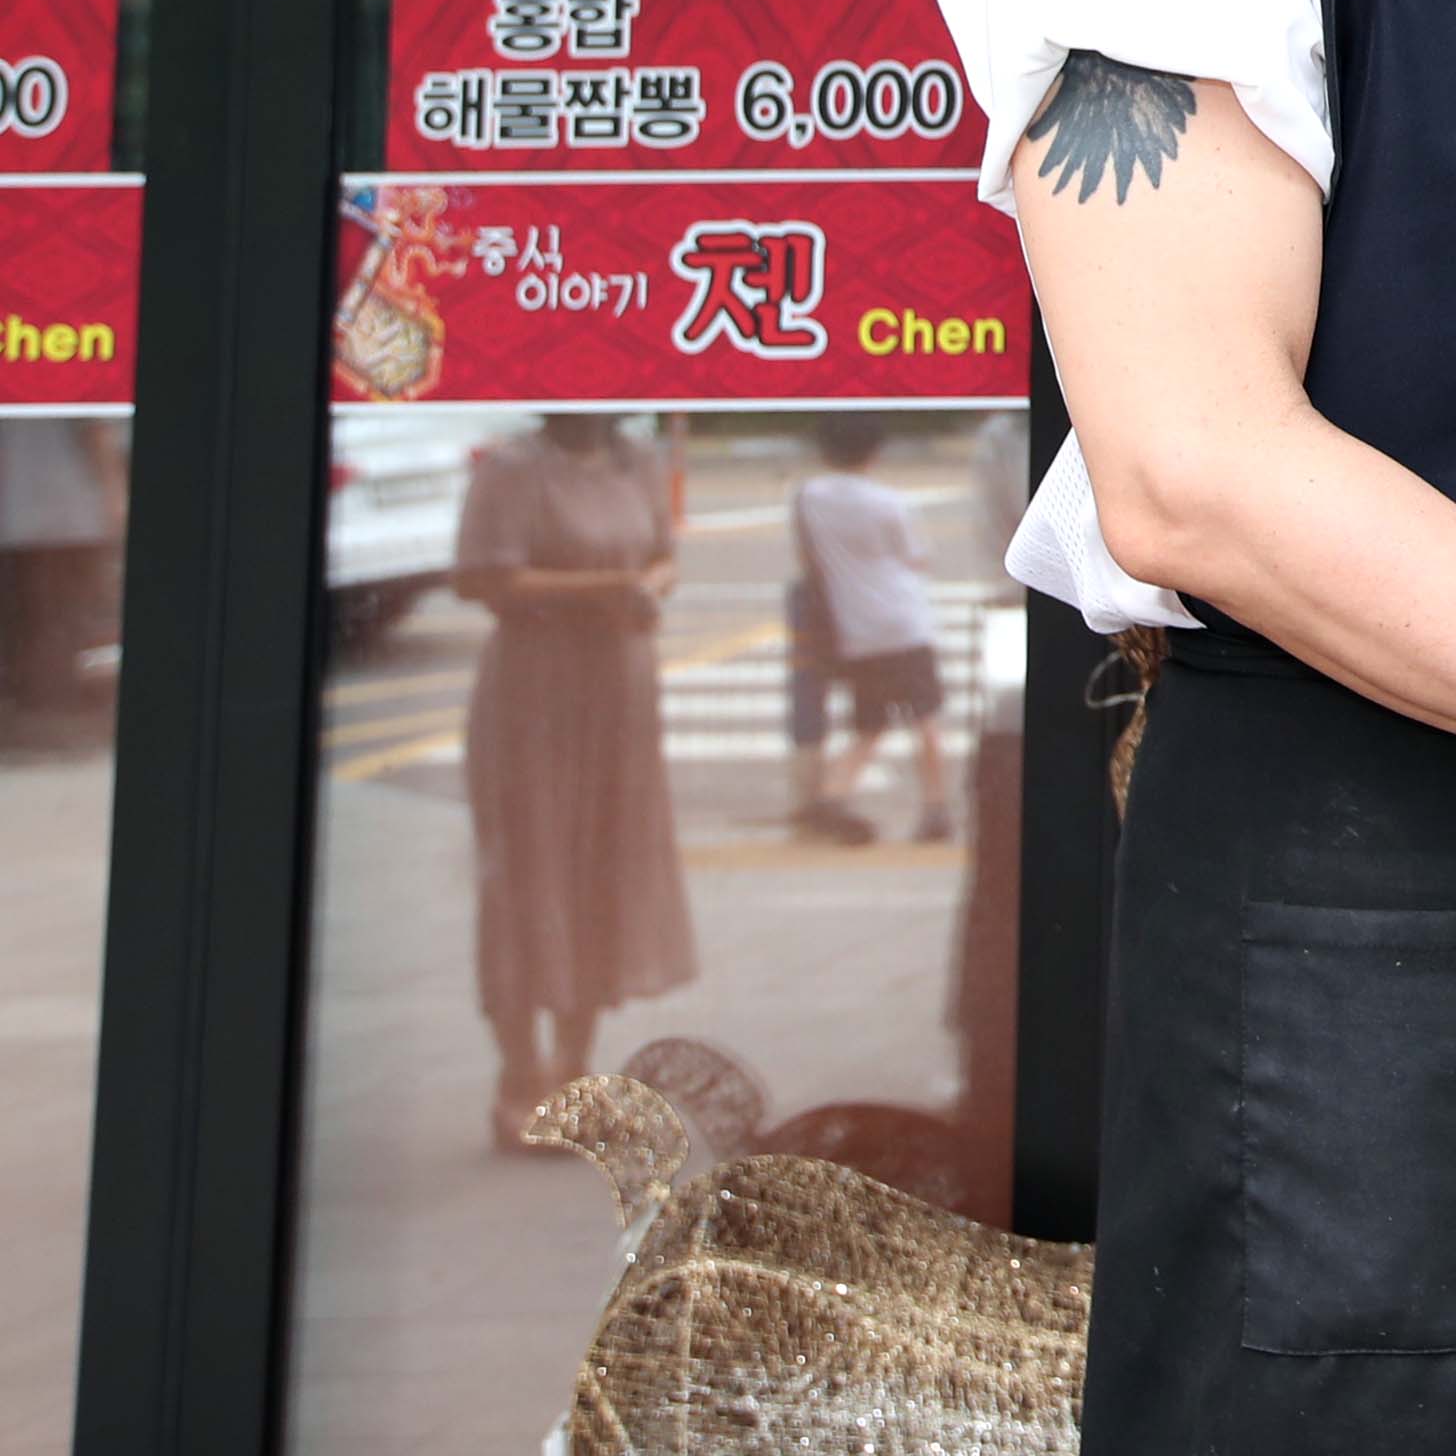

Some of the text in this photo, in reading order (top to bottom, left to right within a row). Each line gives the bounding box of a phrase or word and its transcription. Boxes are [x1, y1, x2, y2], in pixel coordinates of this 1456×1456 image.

[414, 61, 961, 148] 해물짬뽕 6,000
[472, 224, 564, 278] 중식
[515, 271, 649, 318] 이야기
[0, 313, 115, 362] hen
[857, 309, 1006, 357] Chen
